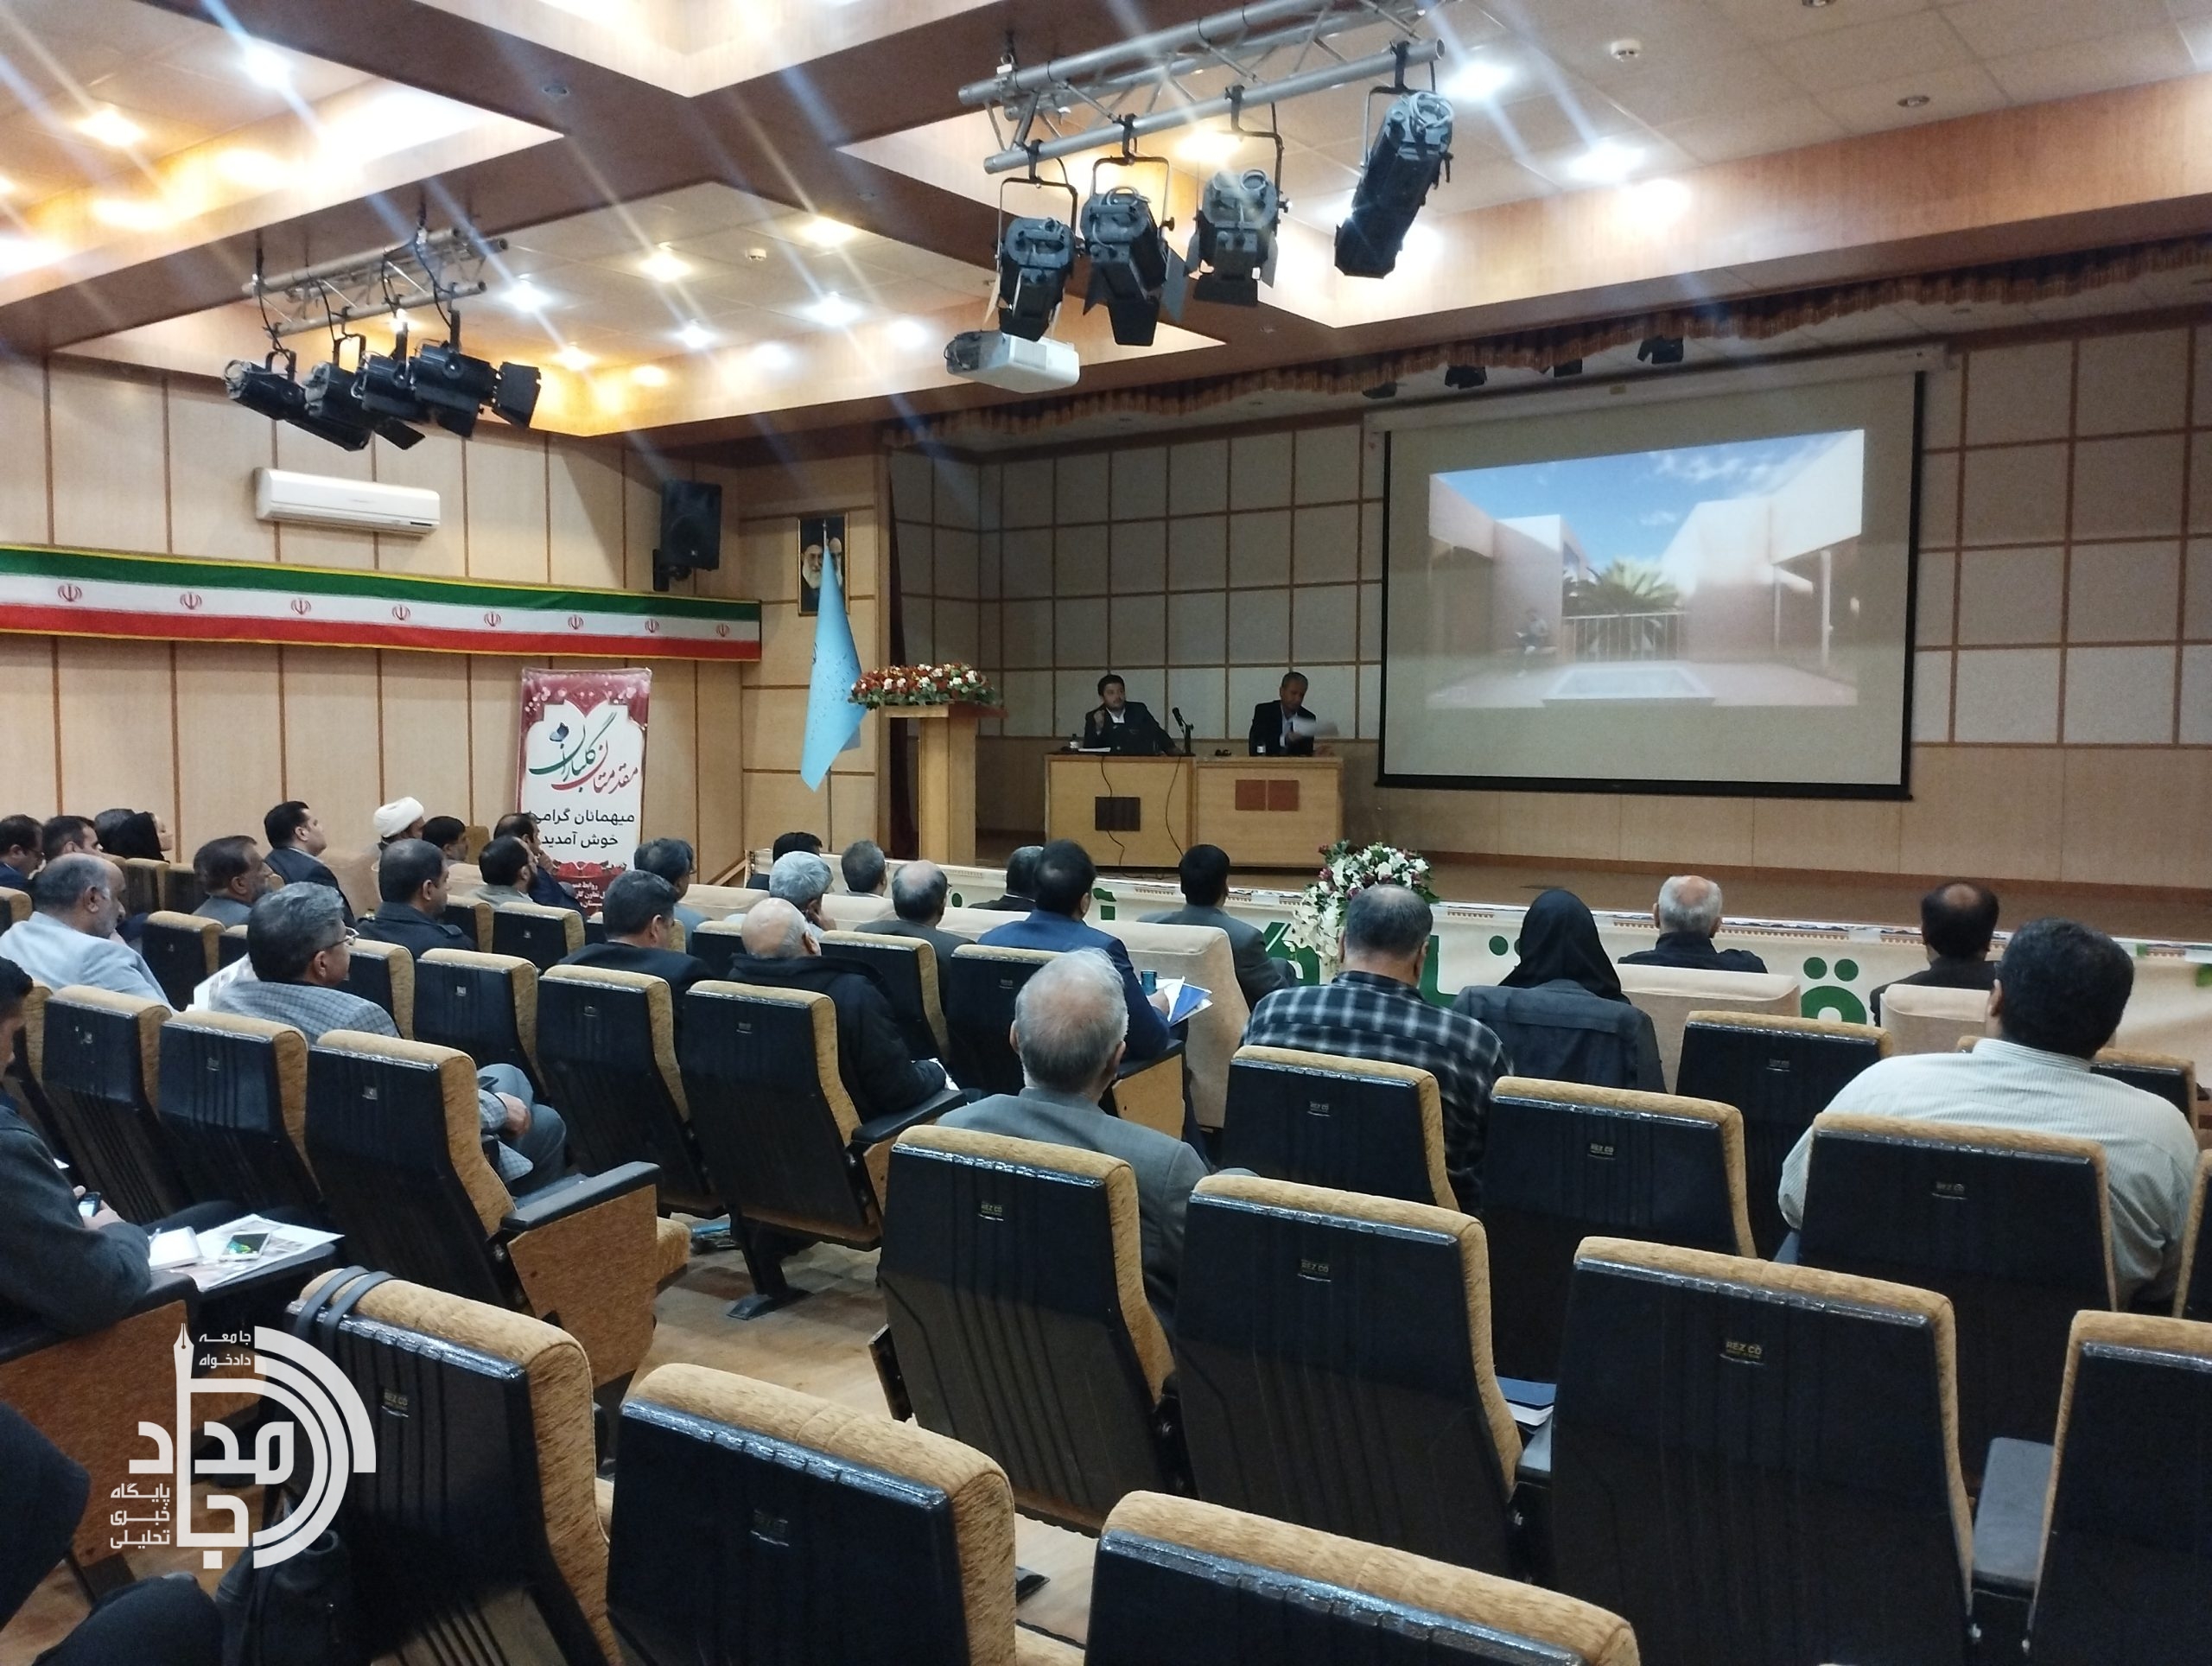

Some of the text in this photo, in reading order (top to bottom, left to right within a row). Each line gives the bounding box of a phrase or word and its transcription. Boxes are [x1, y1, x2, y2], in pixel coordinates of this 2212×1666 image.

[574, 809, 635, 826] میهمانان
[541, 830, 619, 849] خوش آمدید
